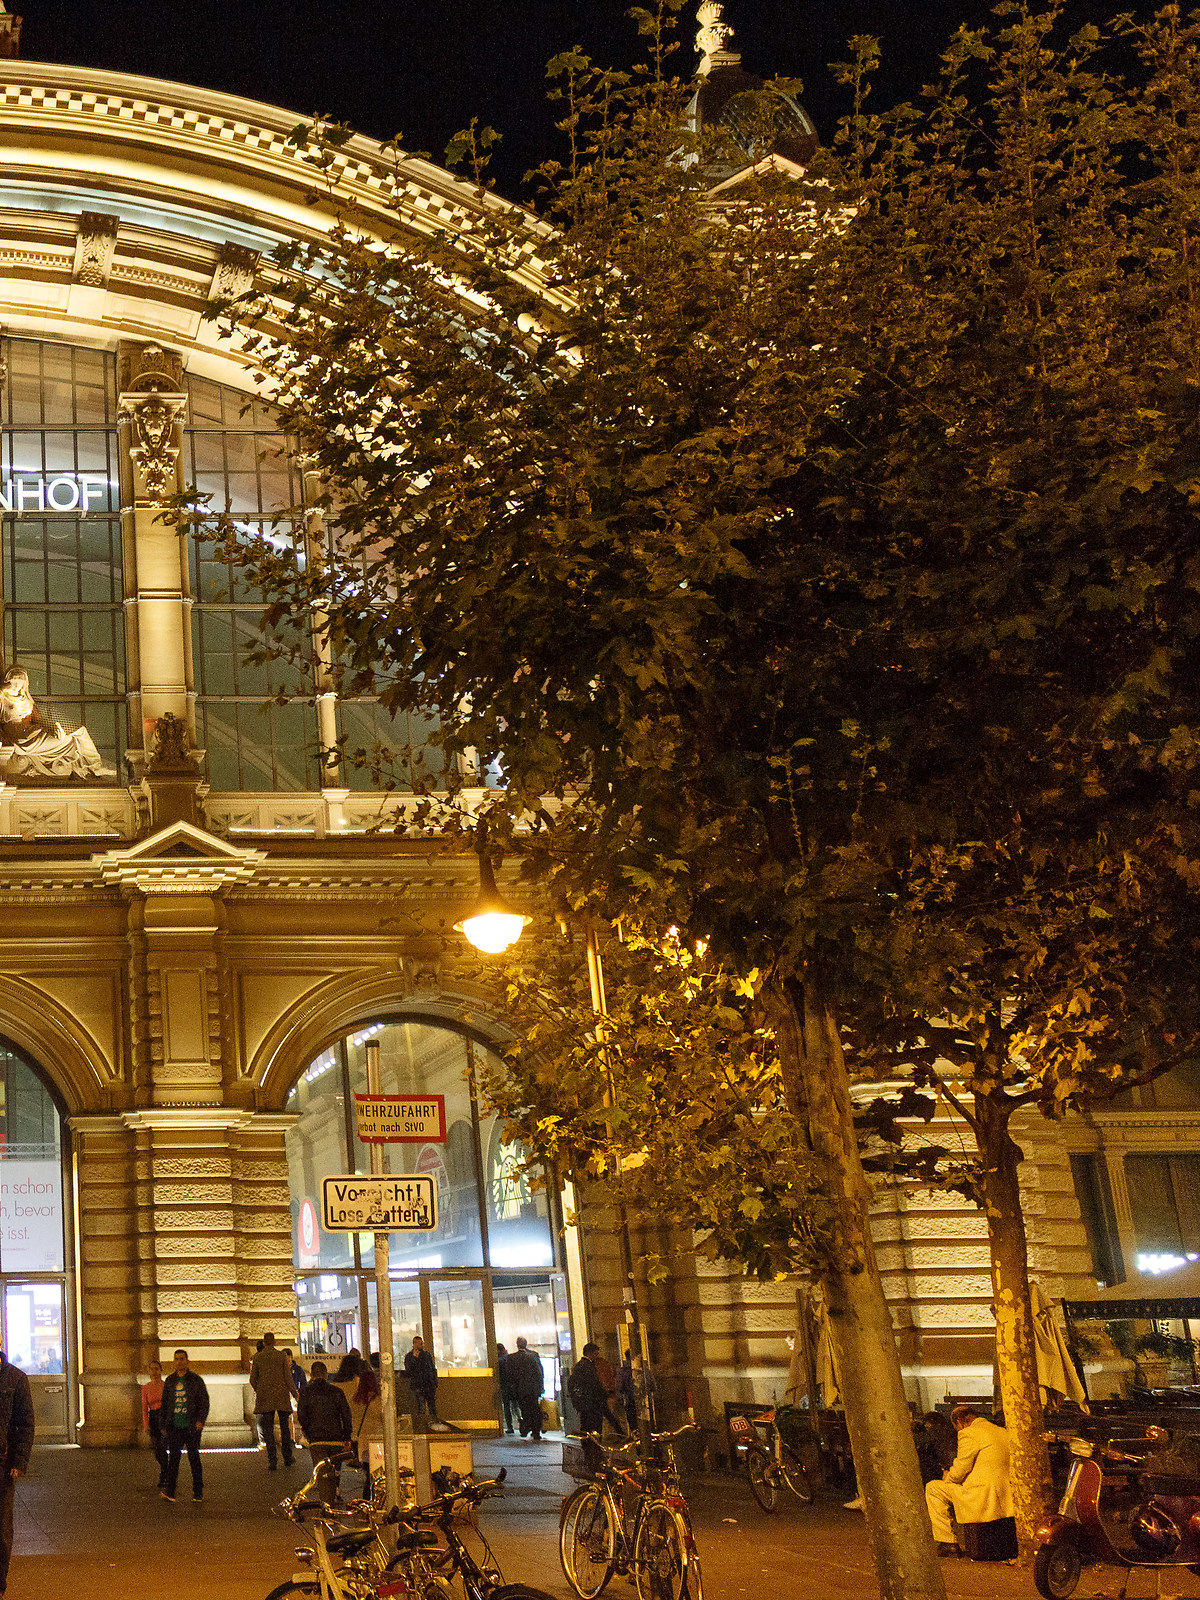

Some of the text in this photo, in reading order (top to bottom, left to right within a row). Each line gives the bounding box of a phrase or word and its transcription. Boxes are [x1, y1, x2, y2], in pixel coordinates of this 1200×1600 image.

[381, 1122, 400, 1131] nach
[405, 1122, 424, 1132] StVO
[13, 1178, 54, 1194] schon
[14, 1201, 55, 1217] bevor
[330, 1206, 364, 1222] Lose
[8, 1227, 29, 1240] isst.
